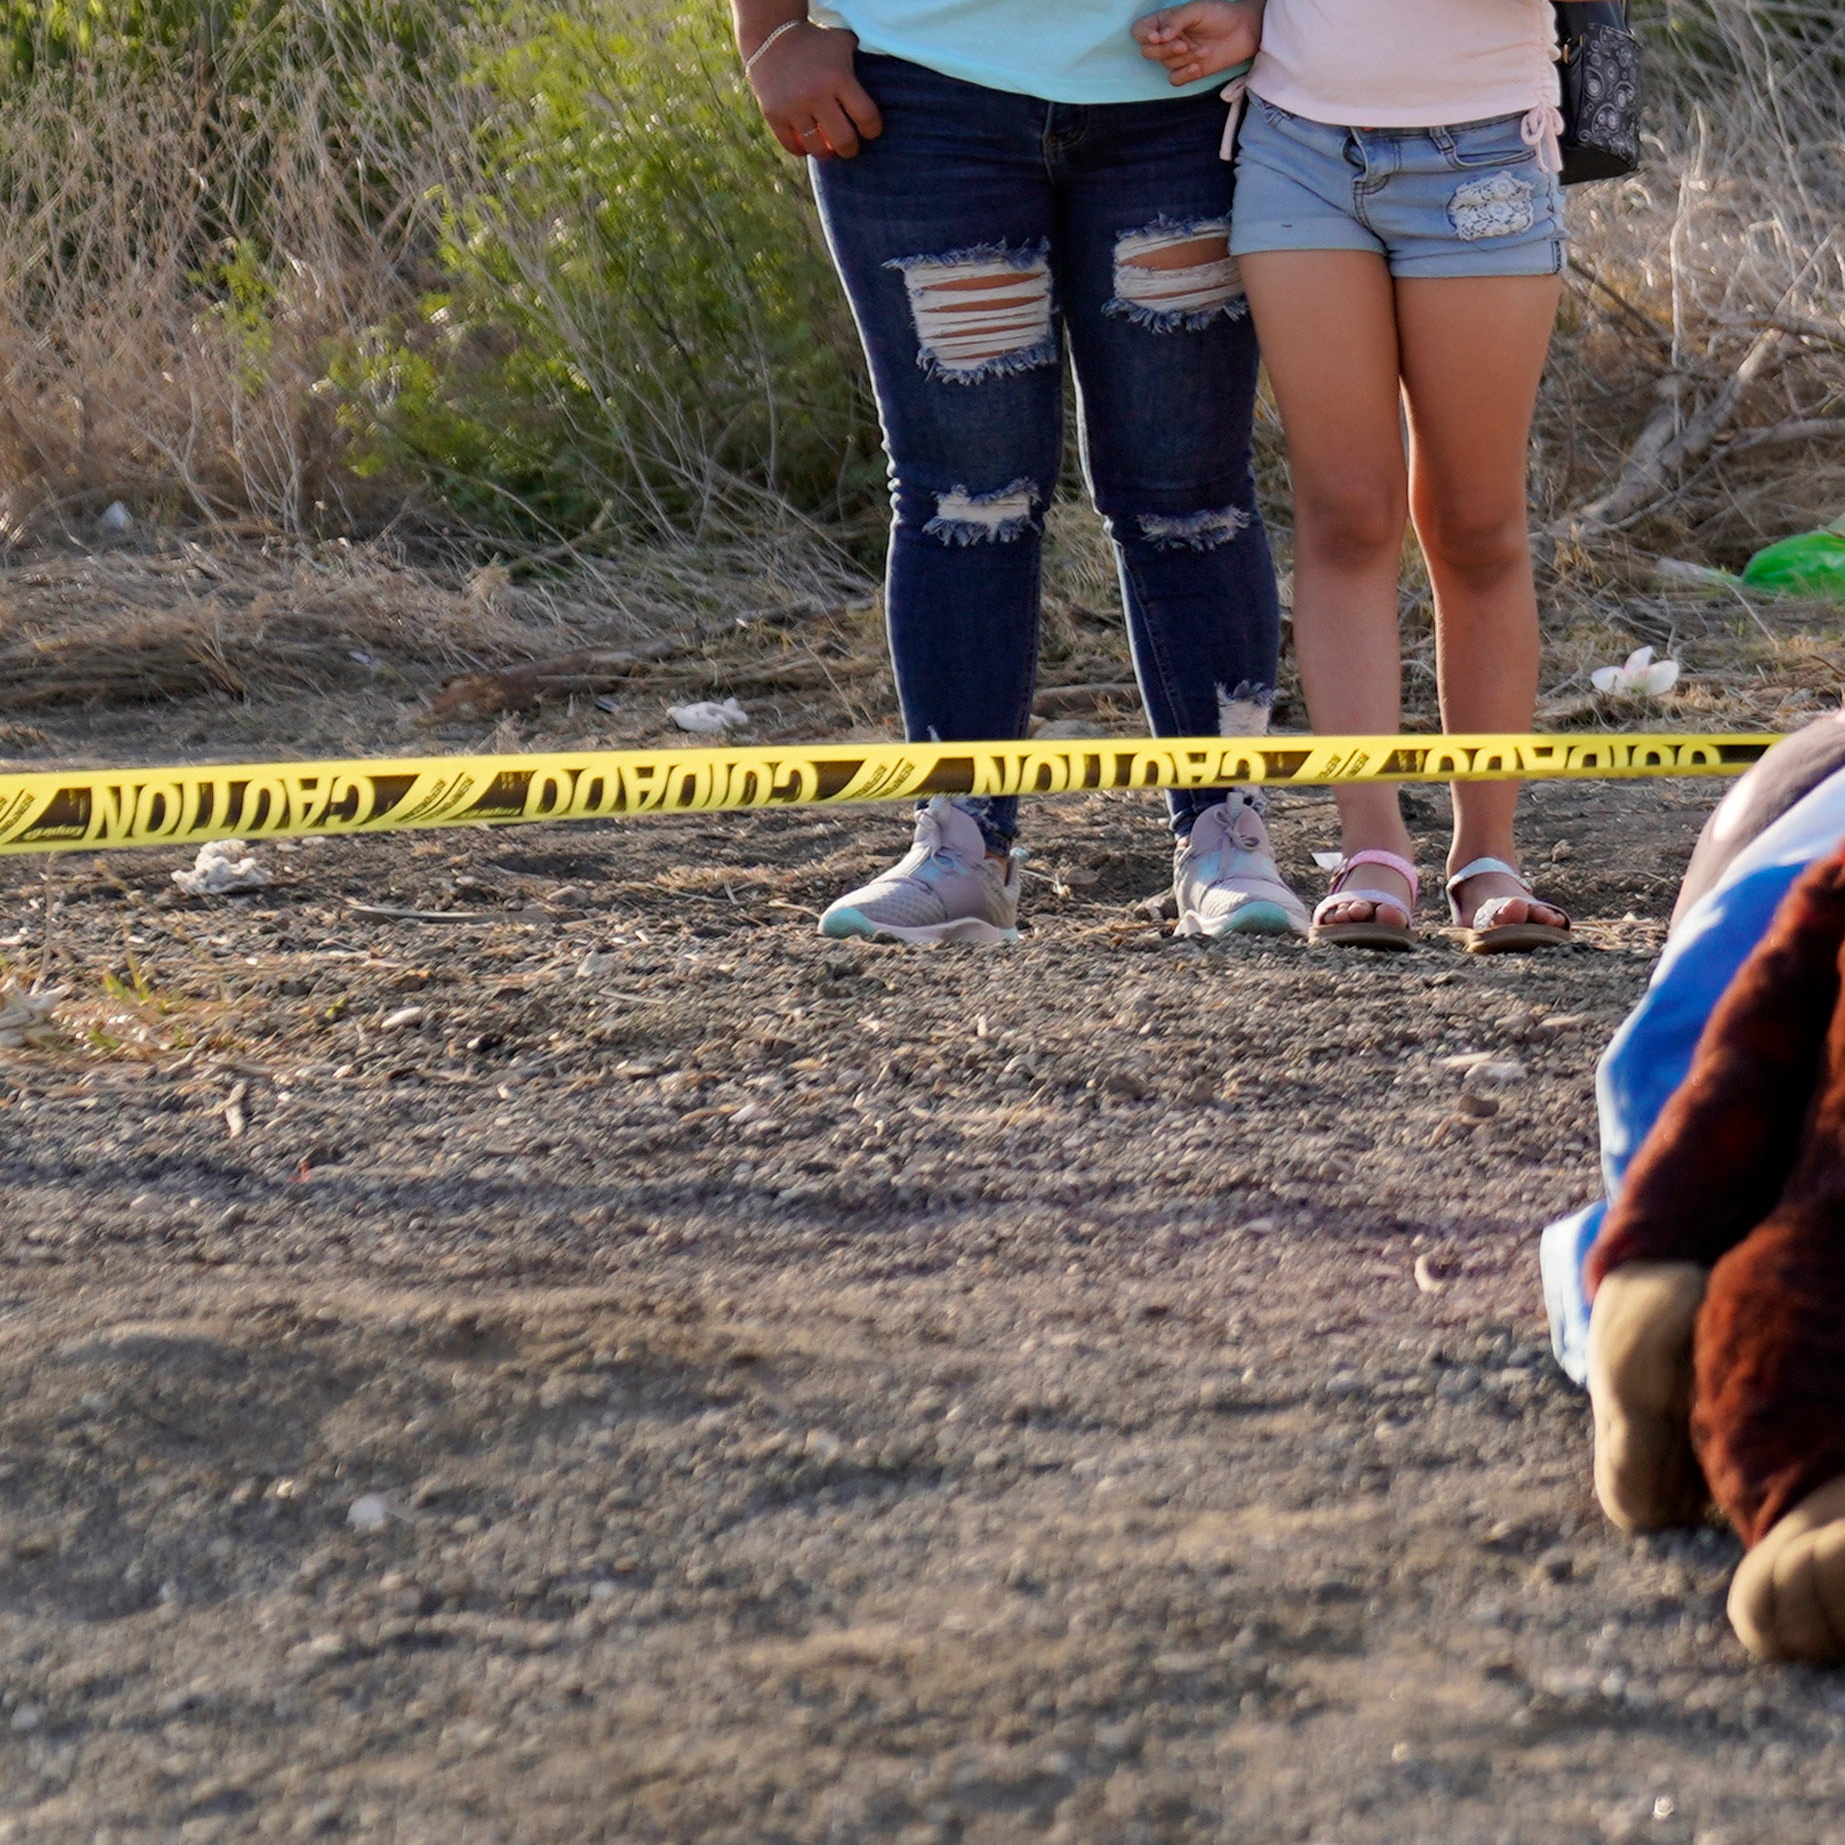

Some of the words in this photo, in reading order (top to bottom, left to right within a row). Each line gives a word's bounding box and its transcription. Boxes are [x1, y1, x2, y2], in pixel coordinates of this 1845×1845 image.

[524, 759, 819, 821] CUIDADO
[972, 751, 1267, 793] CAUTION
[90, 775, 376, 841] CAUTION
